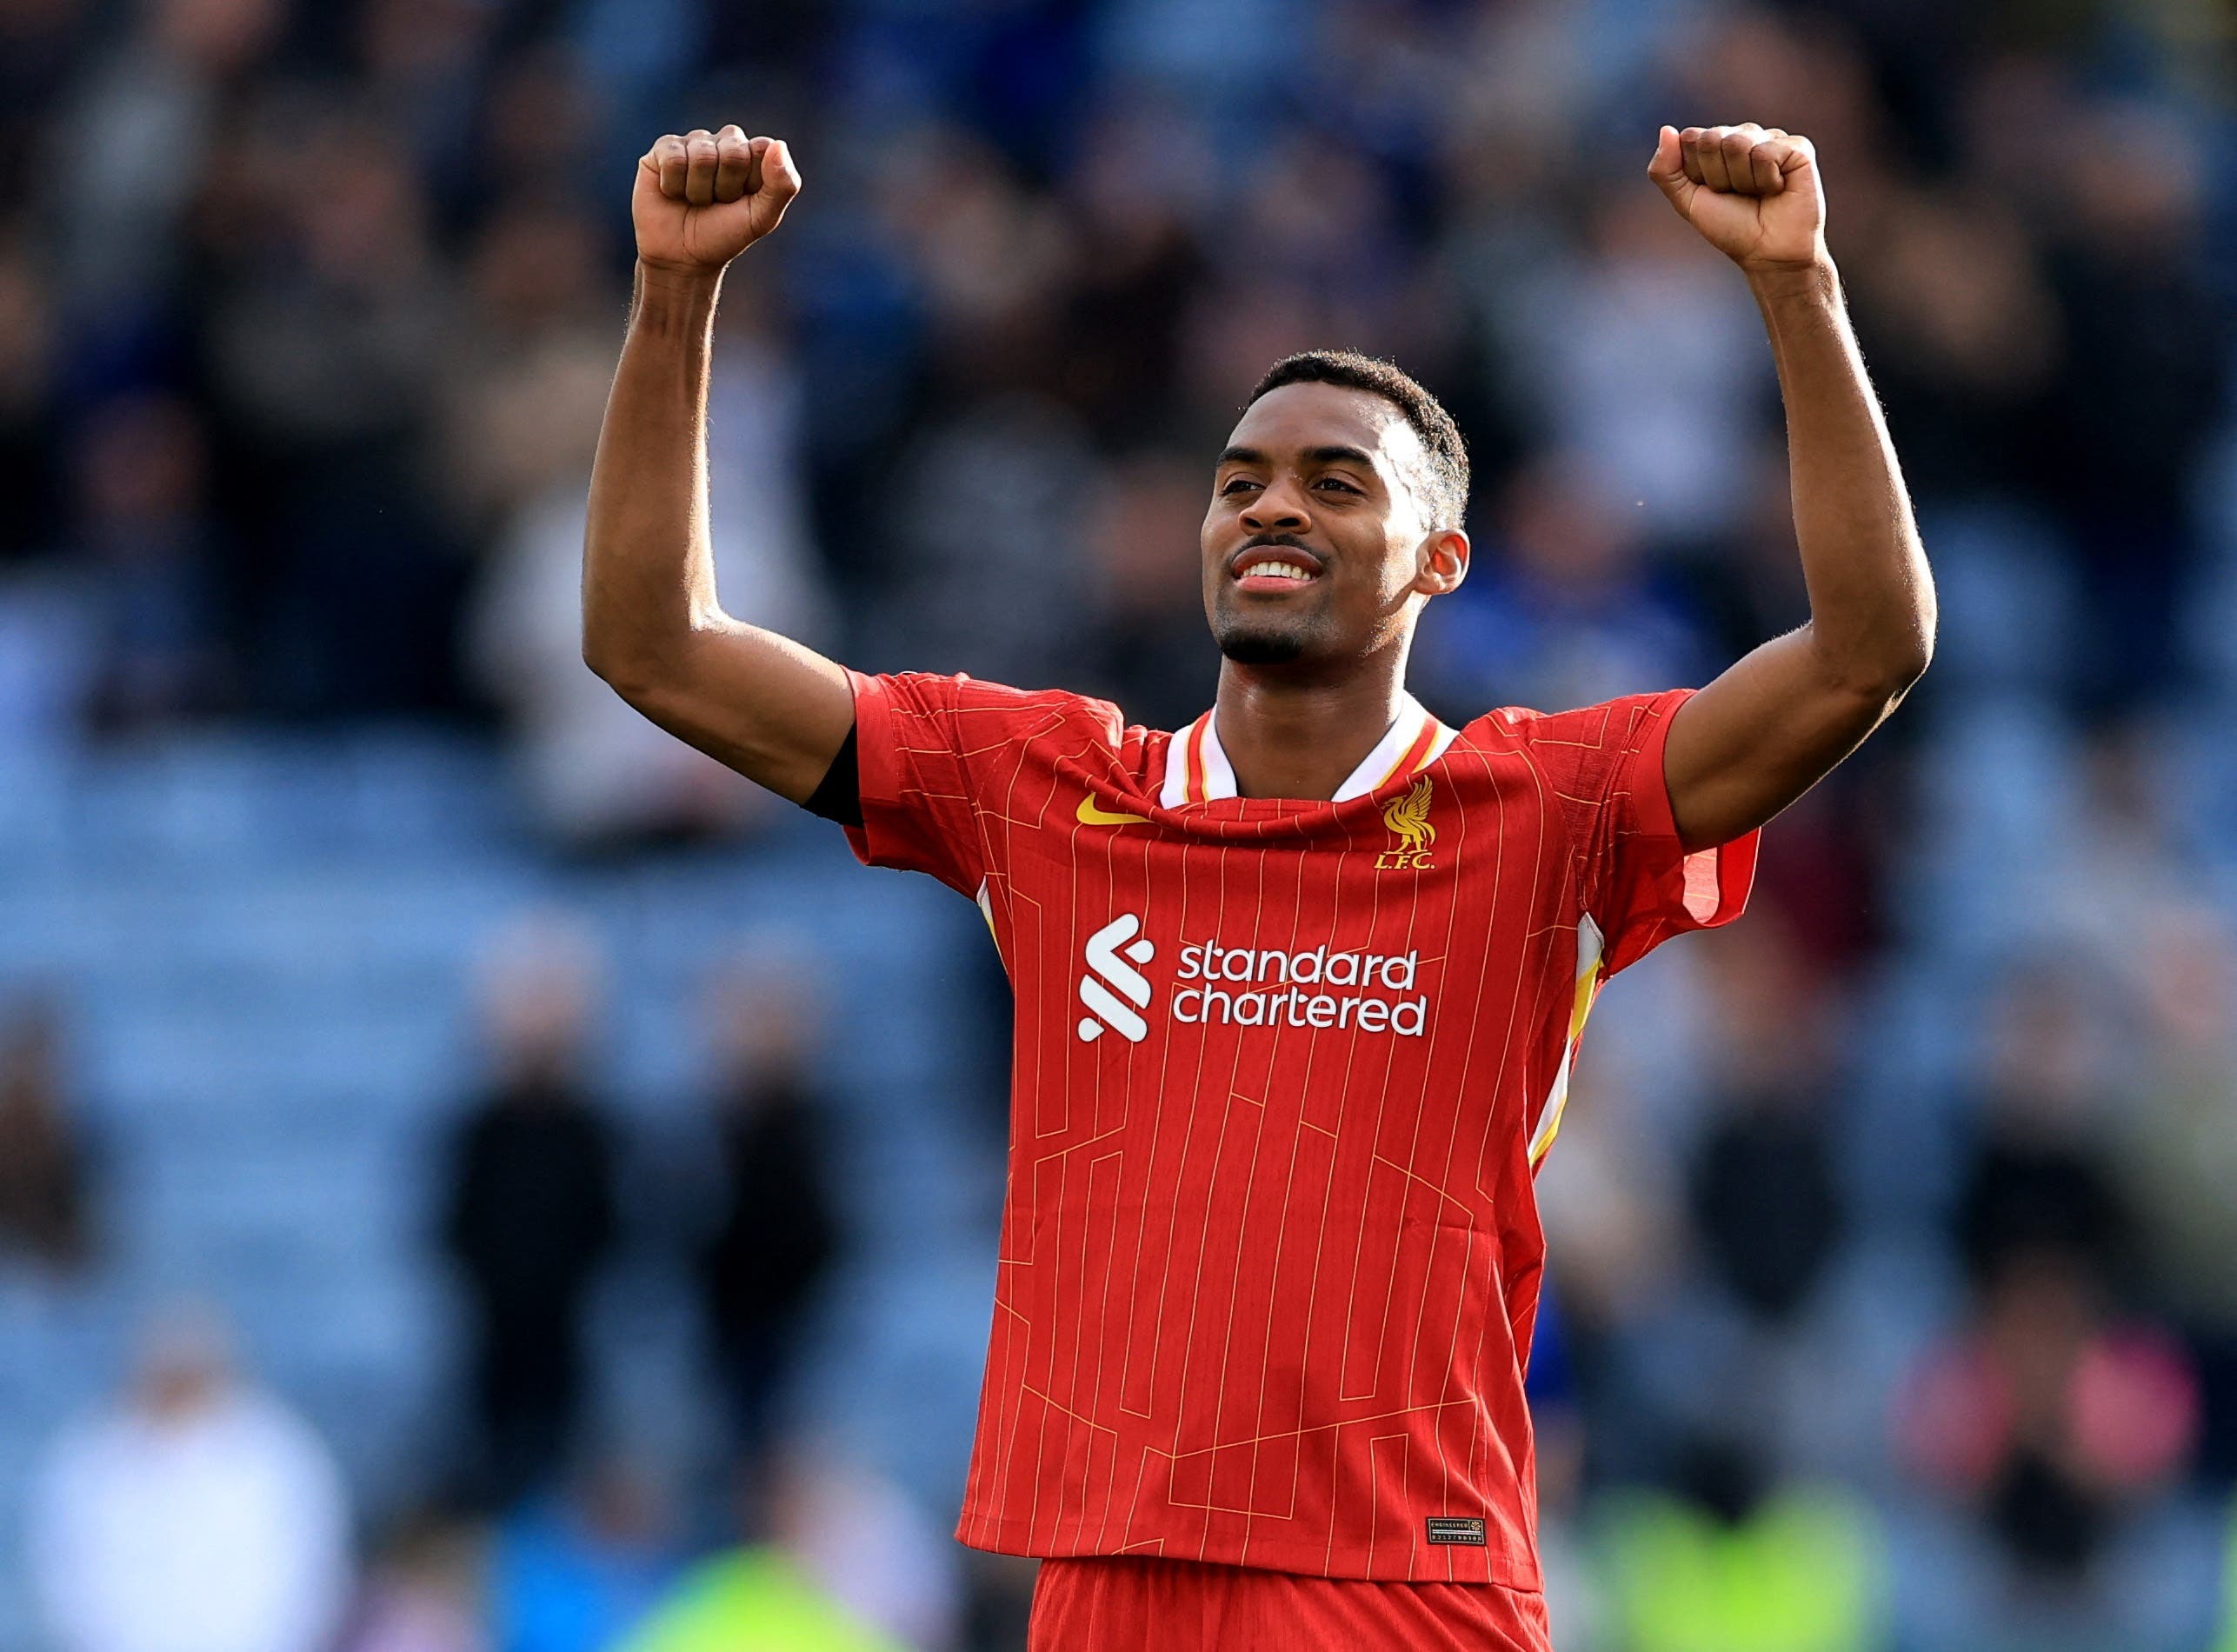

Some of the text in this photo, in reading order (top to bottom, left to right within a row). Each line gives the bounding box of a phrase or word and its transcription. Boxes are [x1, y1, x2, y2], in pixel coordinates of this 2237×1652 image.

[1374, 852, 1435, 869] L.F.C.
[1177, 939, 1417, 990] standard
[1173, 983, 1427, 1036] chartered
